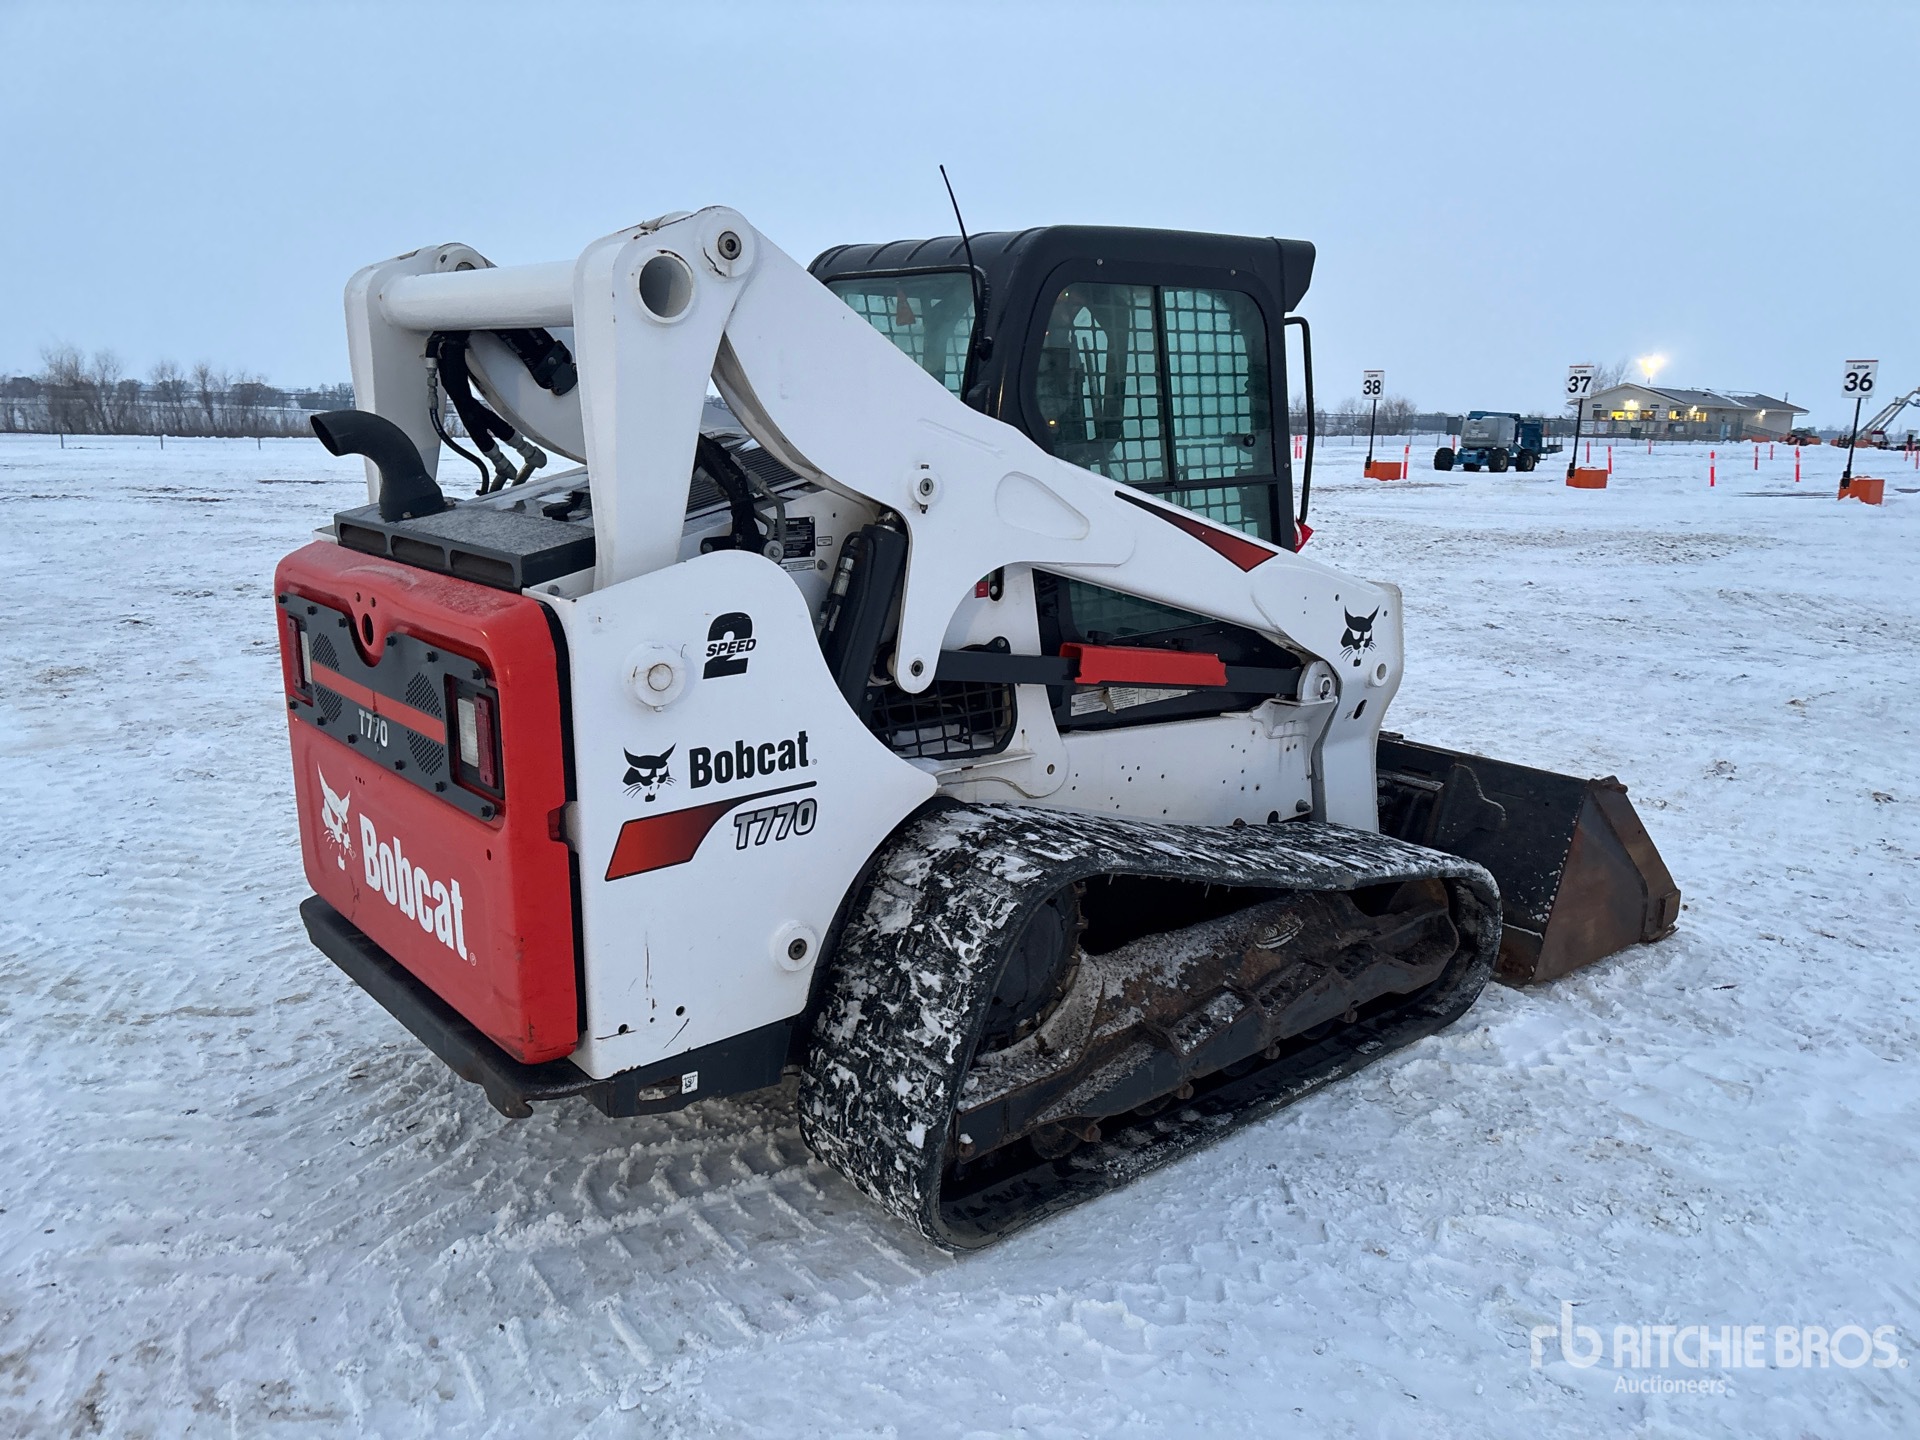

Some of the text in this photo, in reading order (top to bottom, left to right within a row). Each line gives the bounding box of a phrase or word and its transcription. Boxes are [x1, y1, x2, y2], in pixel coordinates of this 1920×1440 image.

[1363, 379, 1381, 395] 38
[1567, 375, 1592, 393] 37
[1844, 371, 1873, 392] 36
[702, 611, 753, 680] 2
[705, 638, 757, 657] SPEED
[358, 708, 388, 748] T770
[689, 730, 809, 789] Bobcat
[733, 797, 818, 850] T770
[359, 812, 468, 961] Bobcat
